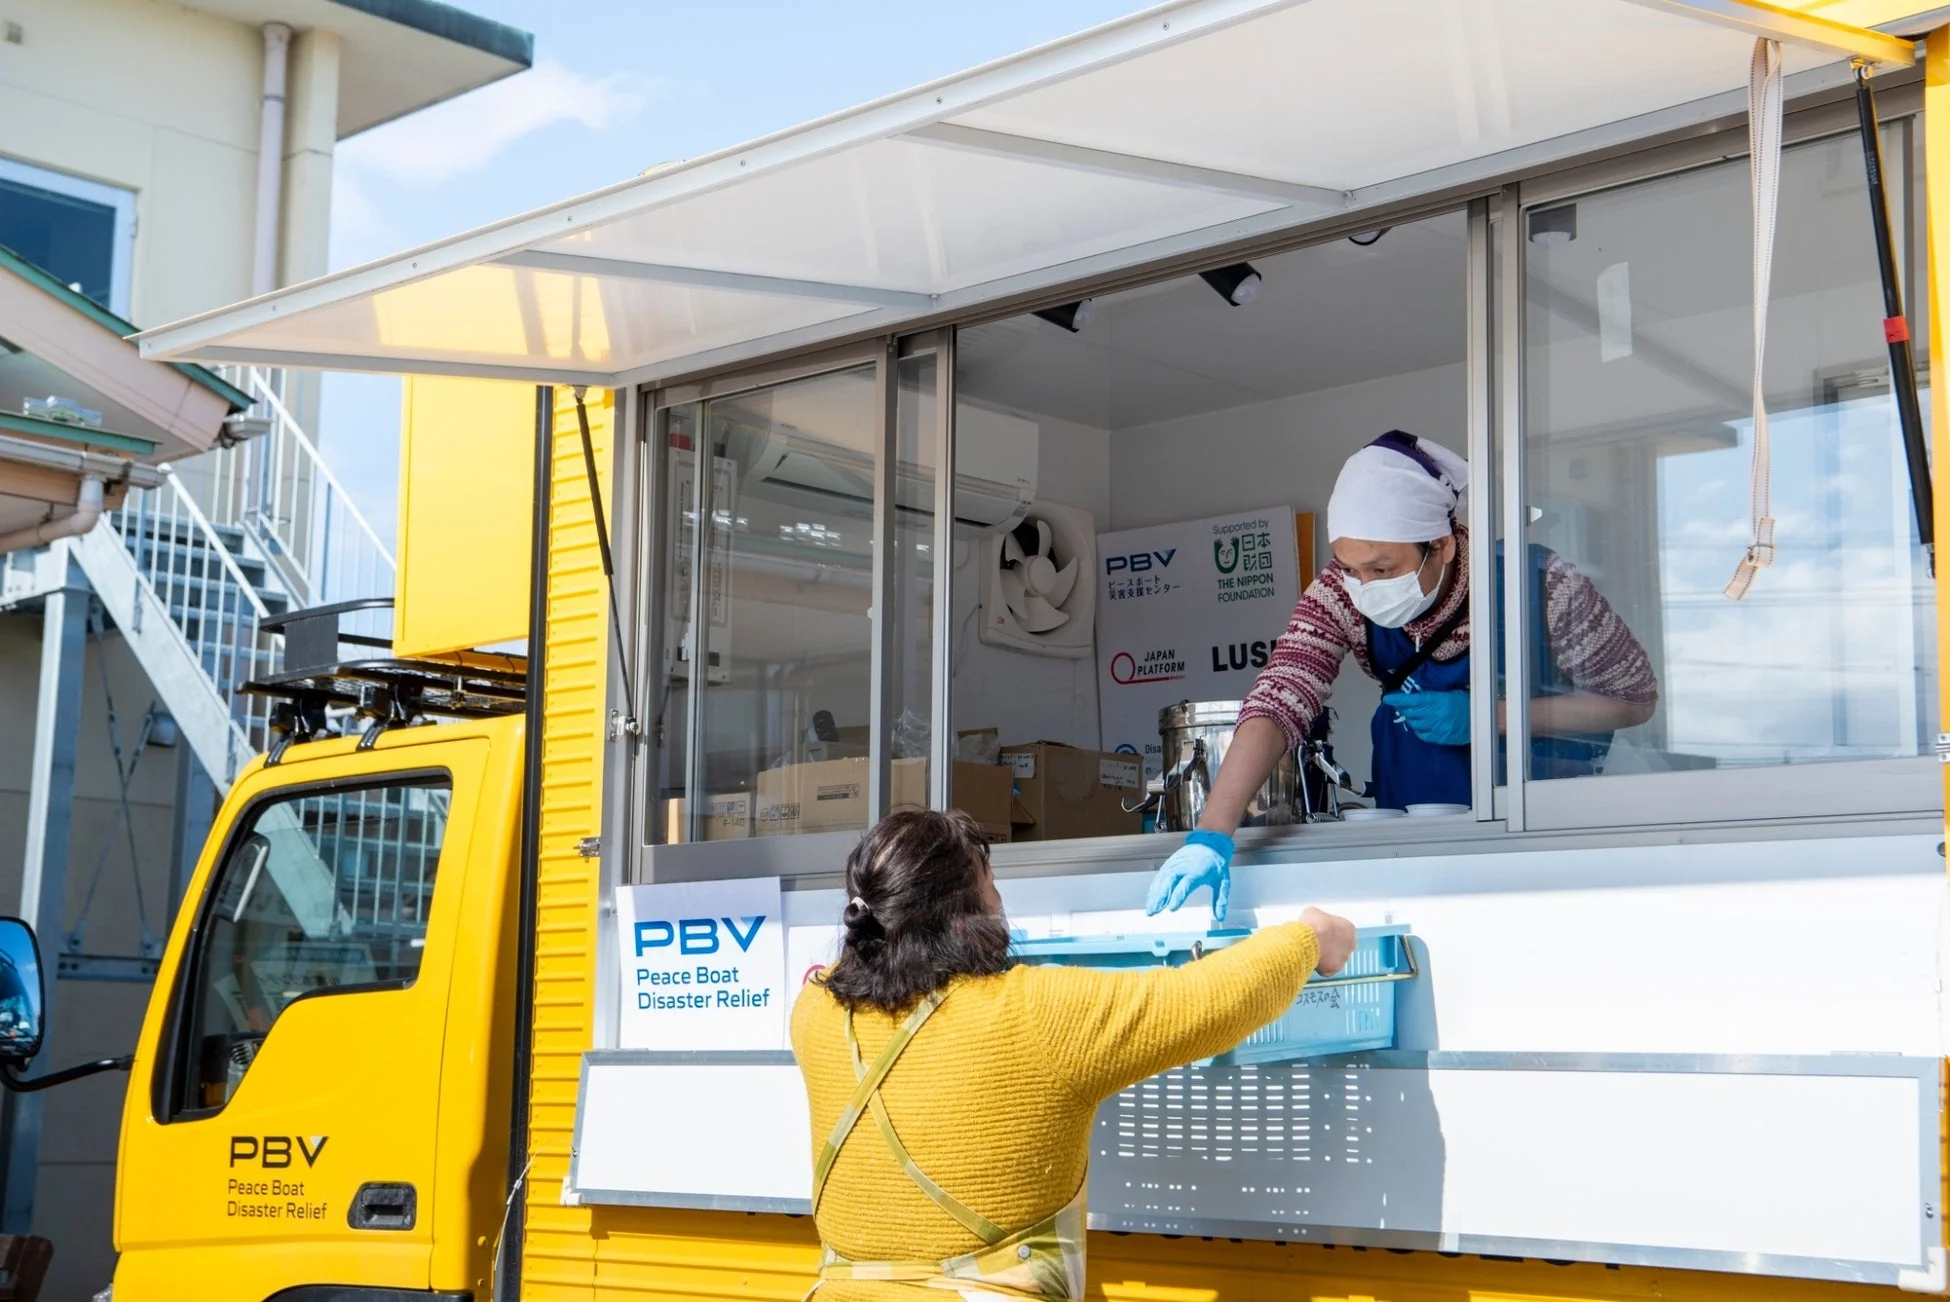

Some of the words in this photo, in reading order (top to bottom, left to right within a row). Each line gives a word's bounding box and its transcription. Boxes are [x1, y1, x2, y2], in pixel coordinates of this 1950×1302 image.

[1213, 521, 1256, 535] Supported
[1258, 519, 1269, 529] by
[1105, 549, 1177, 575] PBV
[1217, 577, 1234, 589] THE
[1237, 572, 1274, 587] NIPPON
[1217, 587, 1275, 603] FOUNDATION
[1144, 649, 1175, 662] JAPAN
[1137, 661, 1185, 676] PLATFORM
[634, 915, 767, 957] PBV
[636, 968, 691, 986] Peace
[696, 966, 739, 984] Boat
[637, 991, 712, 1010] Disaster
[717, 988, 770, 1008] Relief
[229, 1136, 330, 1168] PBV
[228, 1178, 268, 1195] Peace
[272, 1179, 305, 1196] Boat
[227, 1200, 283, 1218] Disaster
[286, 1202, 328, 1220] Relief
